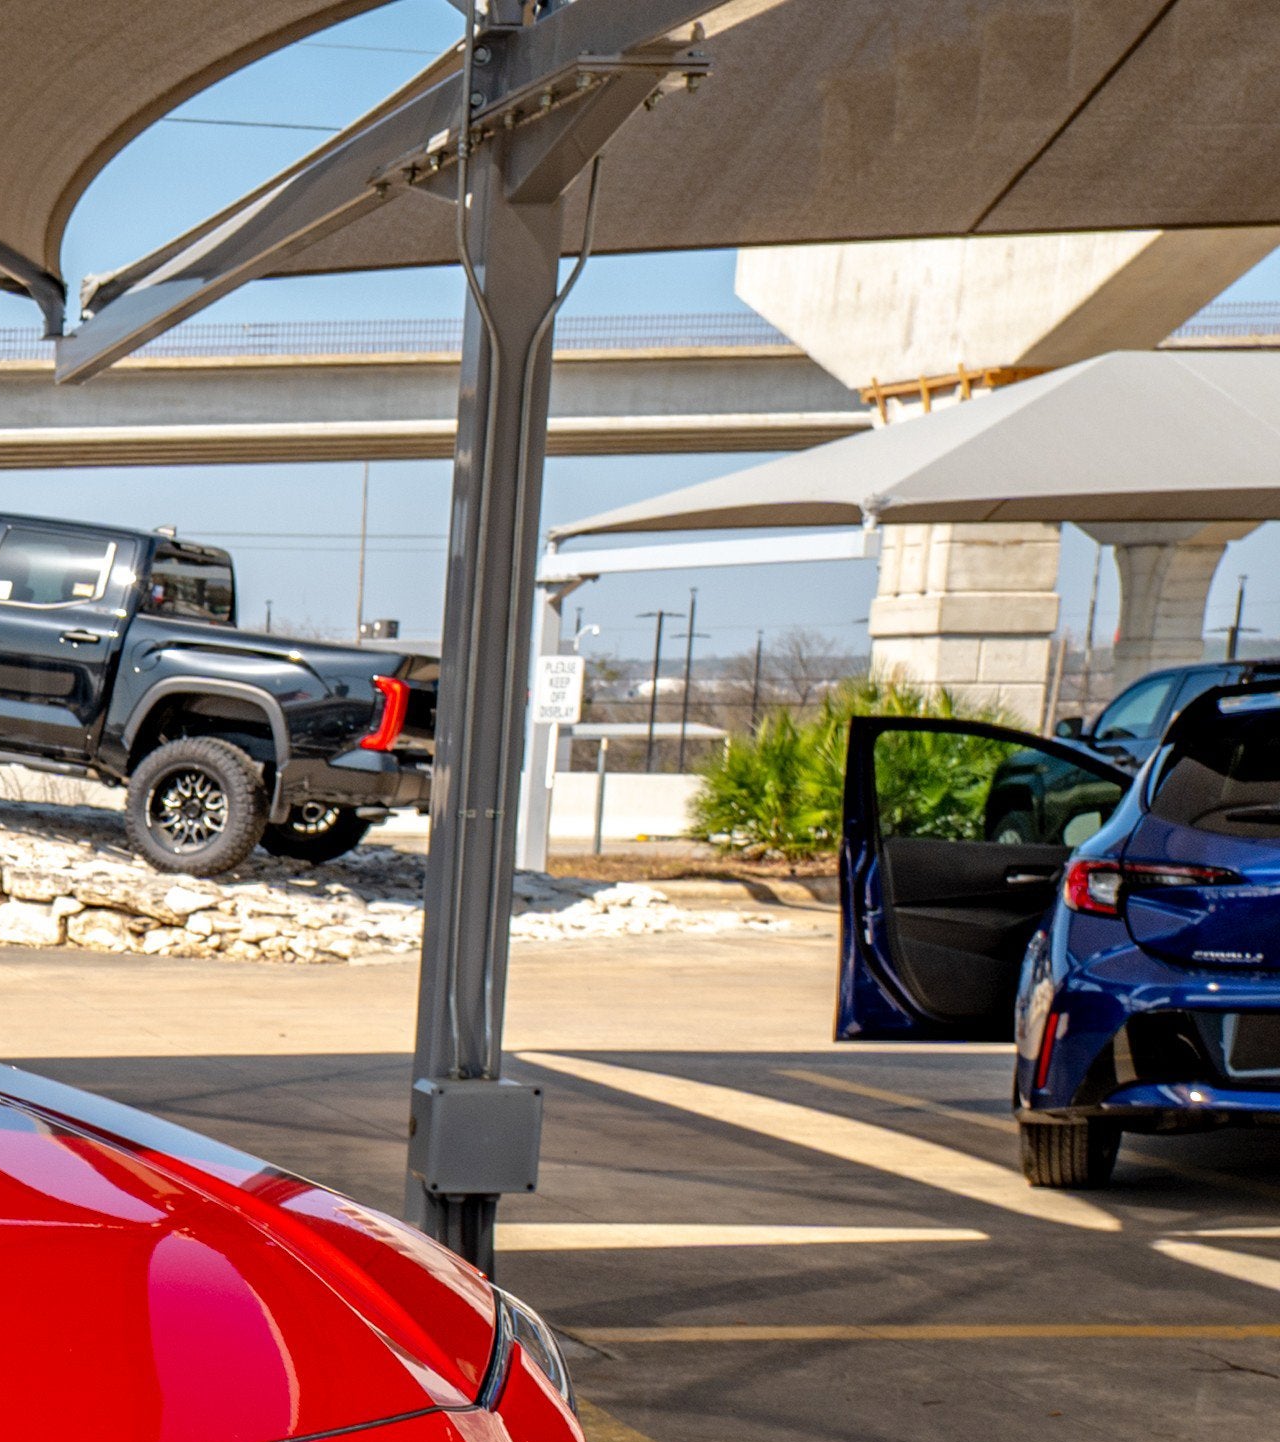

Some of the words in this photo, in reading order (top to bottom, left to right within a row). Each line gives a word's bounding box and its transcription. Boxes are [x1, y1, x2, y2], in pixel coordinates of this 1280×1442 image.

[545, 661, 576, 674] PLEASE
[549, 677, 570, 688] KEEP
[550, 691, 566, 703] OFF
[539, 705, 574, 718] DISPLAY
